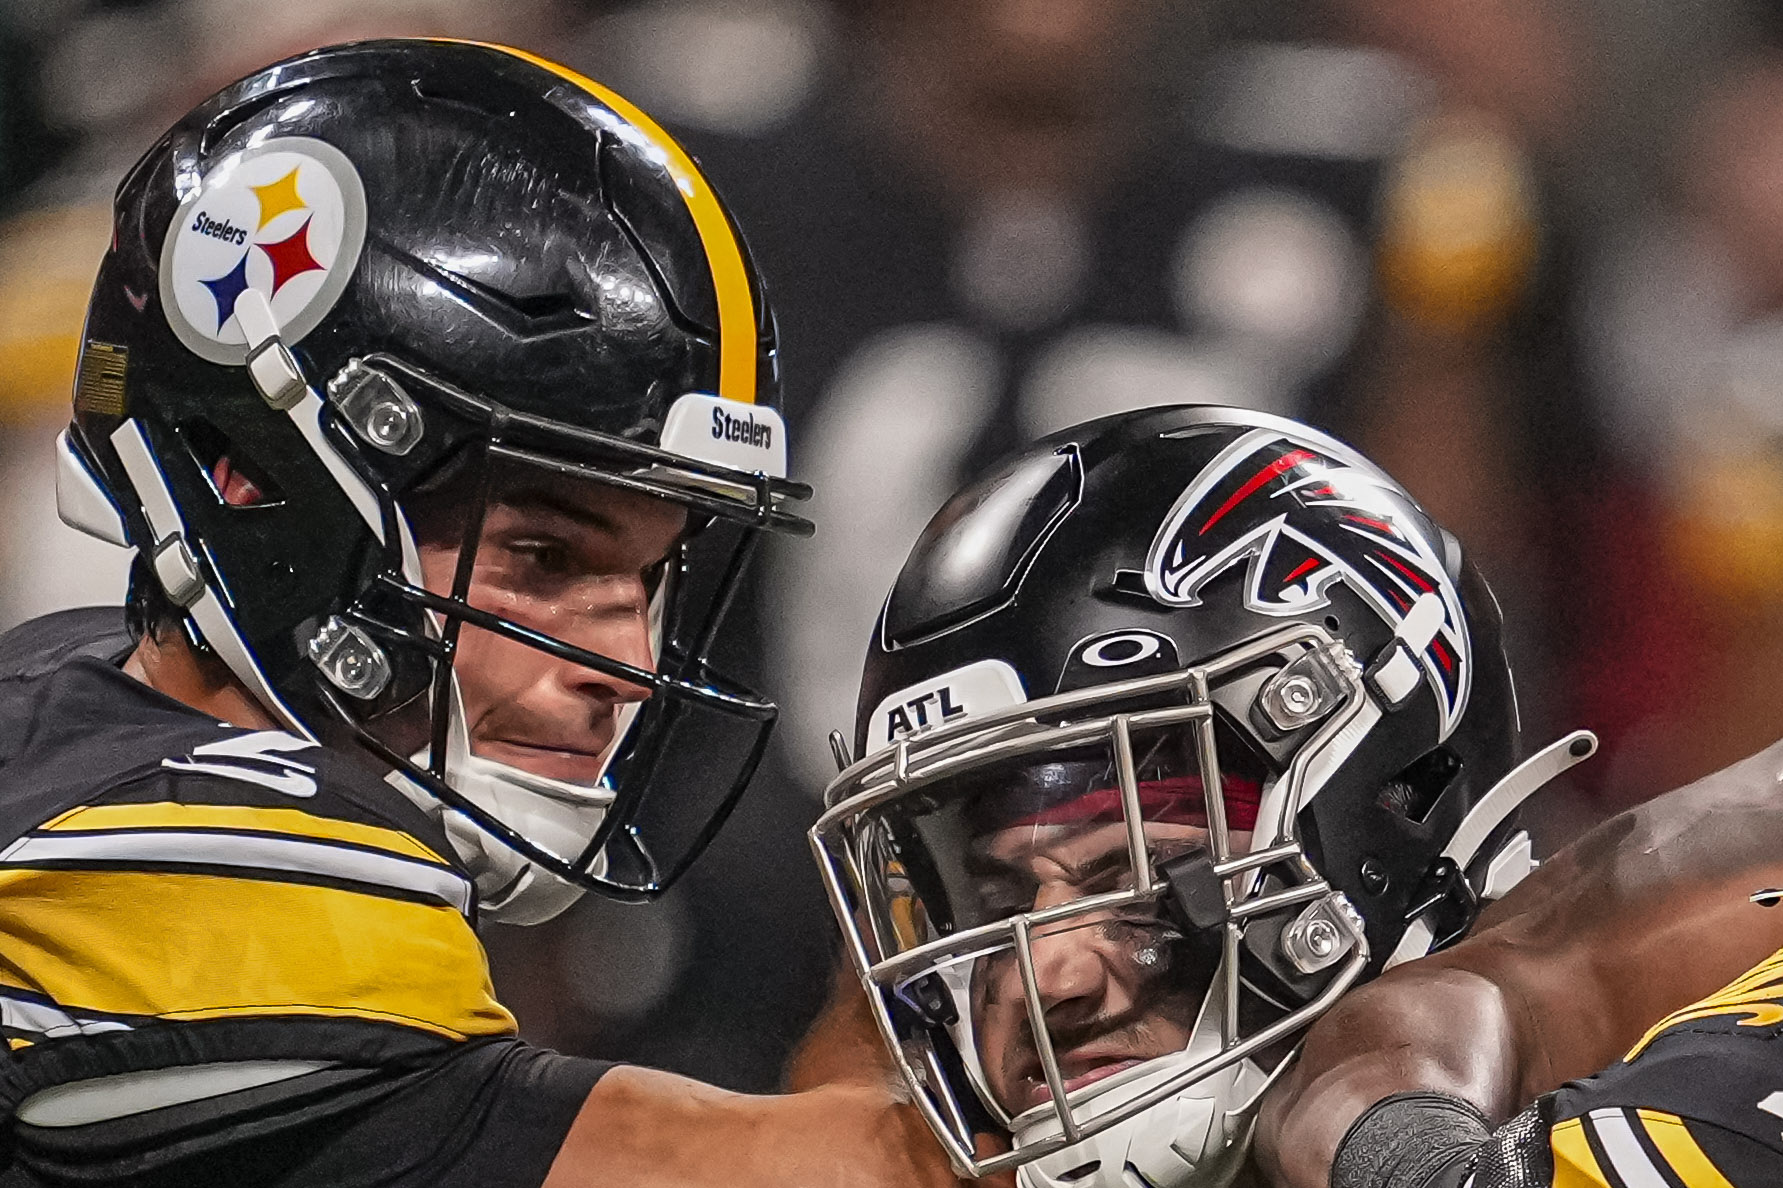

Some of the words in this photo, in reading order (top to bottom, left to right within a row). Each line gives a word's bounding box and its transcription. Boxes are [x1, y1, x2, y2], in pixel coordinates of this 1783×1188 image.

[192, 210, 248, 246] Steelers
[711, 406, 772, 450] Steelers
[887, 686, 964, 742] ATL
